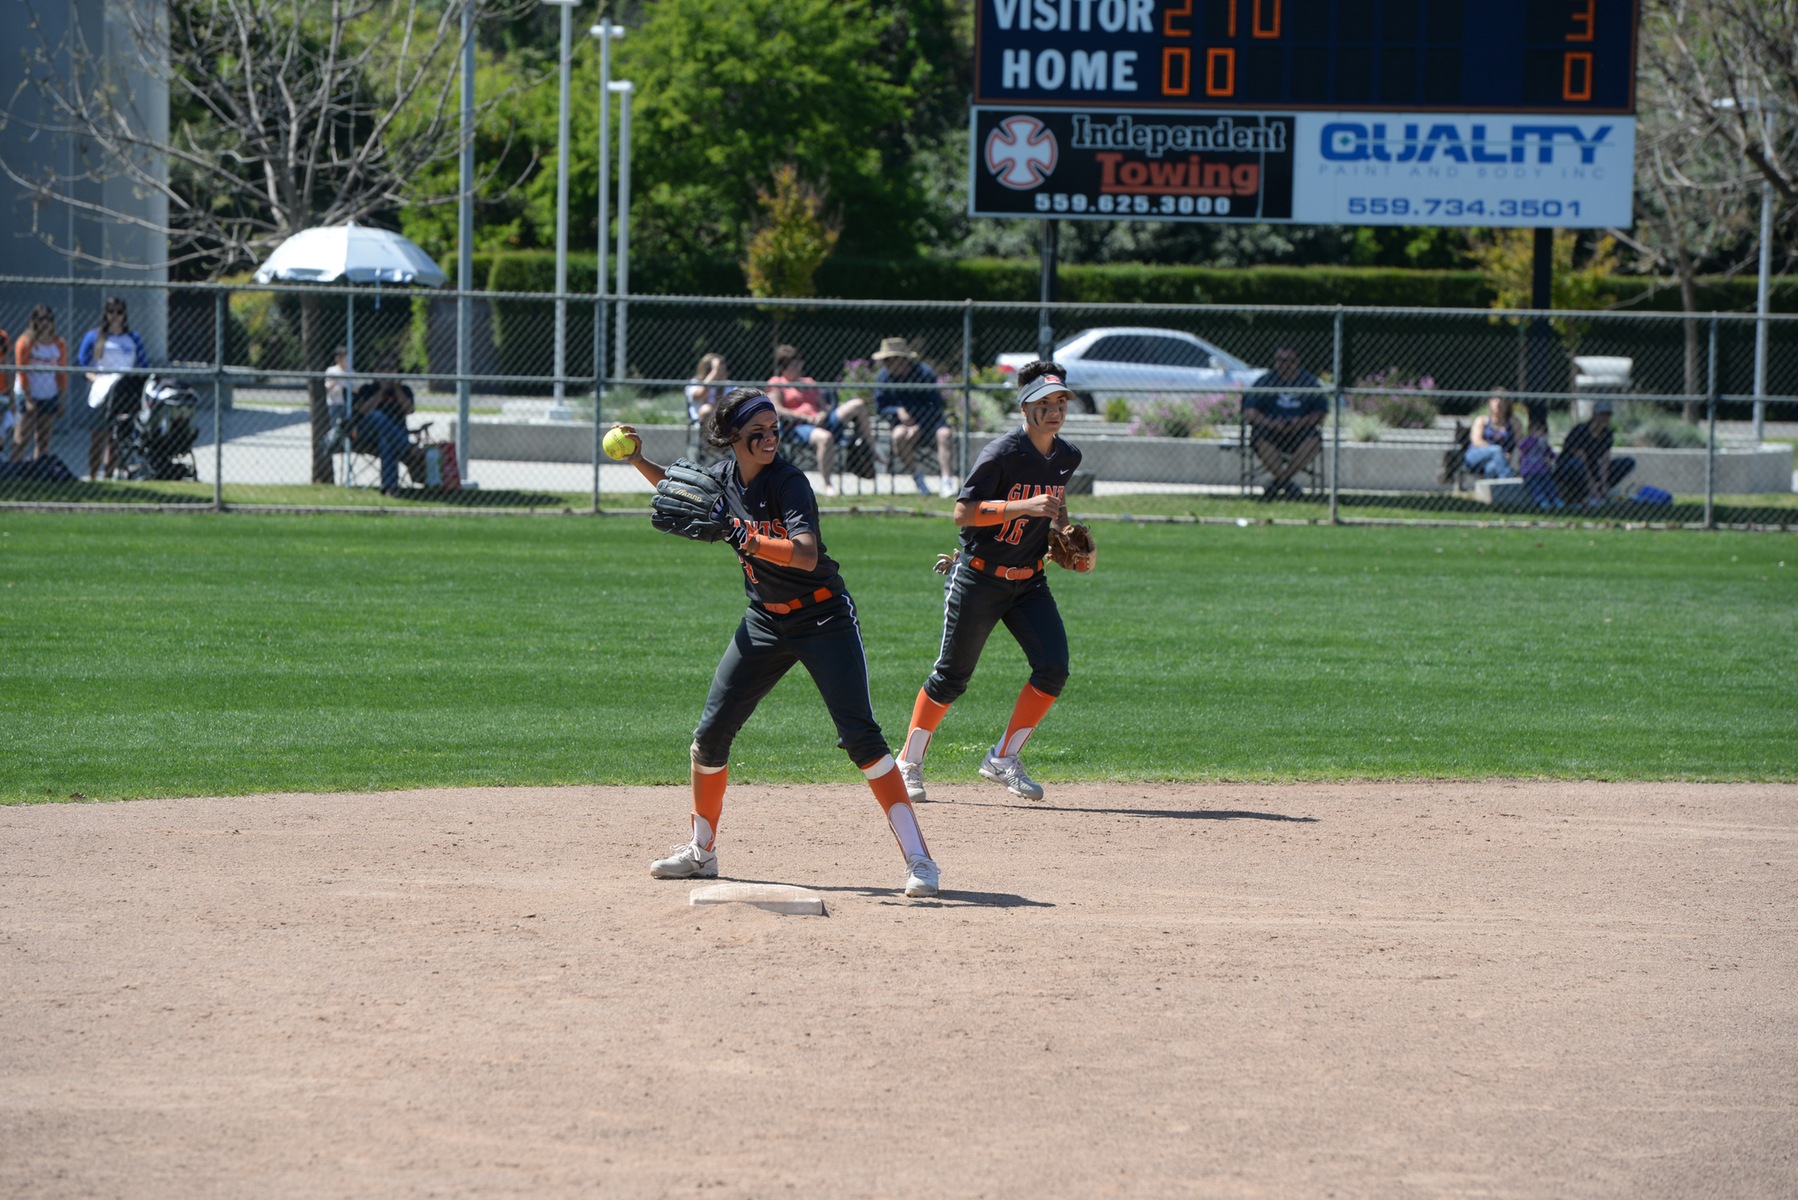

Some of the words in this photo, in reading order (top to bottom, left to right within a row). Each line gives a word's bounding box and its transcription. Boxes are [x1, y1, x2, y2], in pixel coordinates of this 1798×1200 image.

[993, 0, 1154, 32] VISITOR
[1002, 48, 1138, 91] HOME
[1563, 51, 1593, 101] 0
[1071, 114, 1286, 157] Independent
[1319, 122, 1614, 165] QUALITY
[1096, 152, 1260, 196] Towing
[1318, 164, 1392, 178] PAINT
[1409, 166, 1460, 179] AND
[1477, 167, 1545, 180] BODY
[1561, 167, 1606, 181] INC
[1034, 193, 1232, 215] 559.625.3000
[1348, 198, 1581, 218] 559.734.3501
